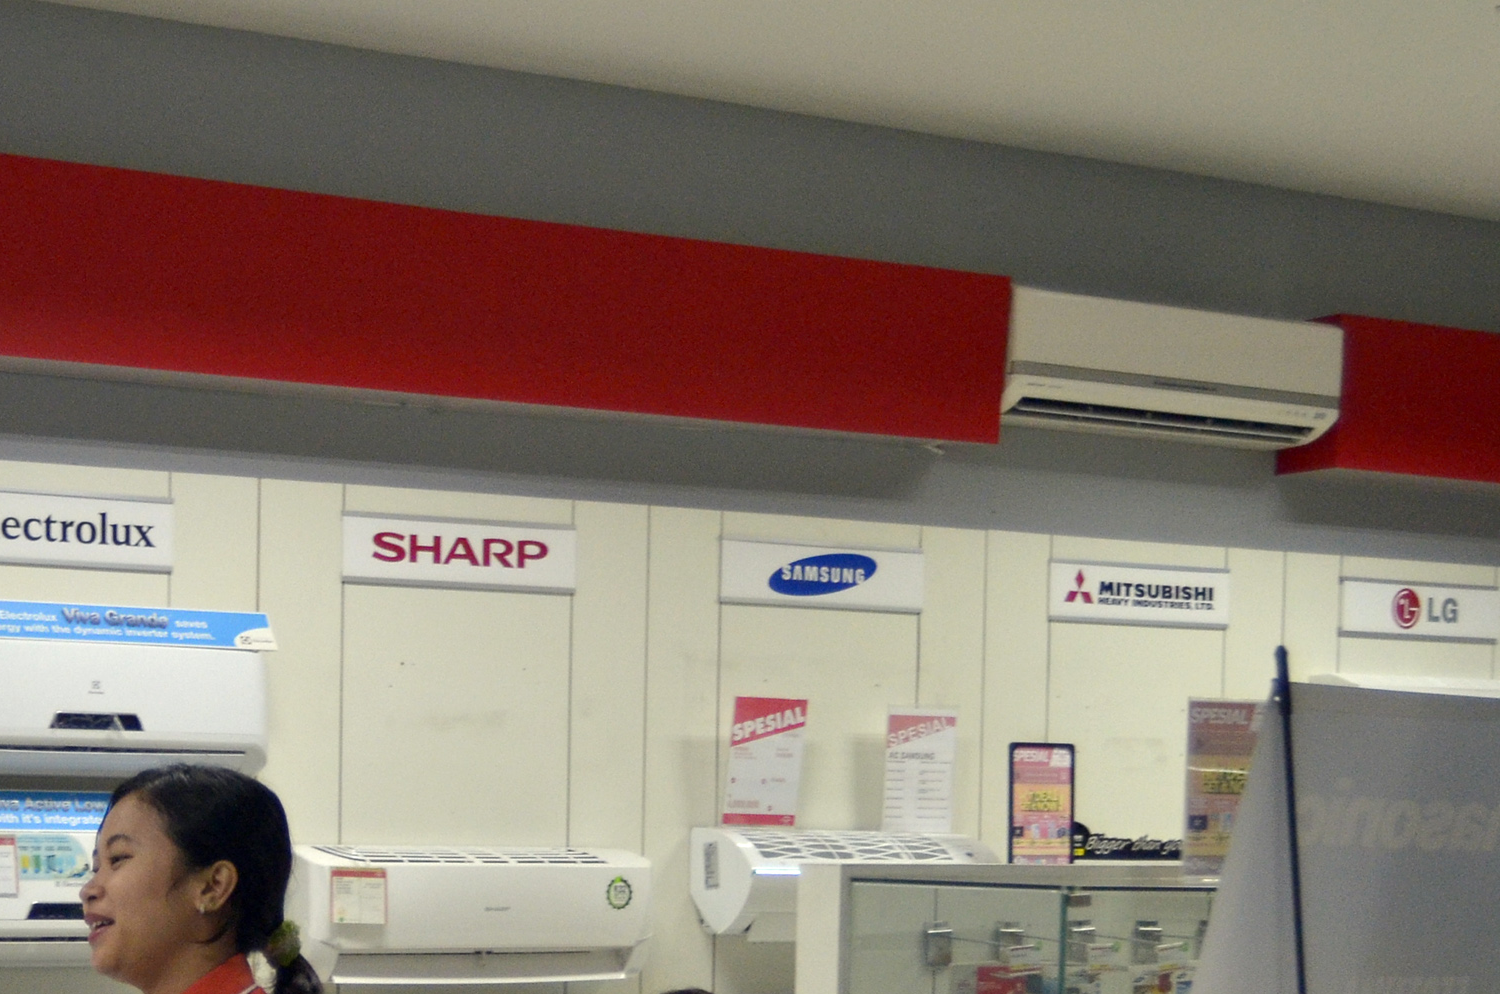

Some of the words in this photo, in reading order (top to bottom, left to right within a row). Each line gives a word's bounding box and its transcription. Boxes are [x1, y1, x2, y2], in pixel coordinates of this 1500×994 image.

[371, 531, 549, 569] SHARP
[781, 564, 866, 585] SAMSUNG
[1099, 580, 1215, 601] MITSUBISHI
[1098, 597, 1129, 607] HEAVY
[1427, 596, 1459, 624] LG
[61, 607, 101, 626] Viva
[103, 609, 169, 630] Grande
[174, 619, 209, 630] saves
[24, 623, 50, 633] with
[51, 625, 72, 634] the
[73, 625, 124, 638] dynamic
[125, 629, 169, 638] inverter
[732, 706, 806, 742] SPESIAL
[886, 717, 954, 749] SPESIAL
[23, 797, 72, 812] Active
[21, 813, 42, 824] it's
[1085, 833, 1132, 855] Bigger
[1132, 835, 1163, 852] than
